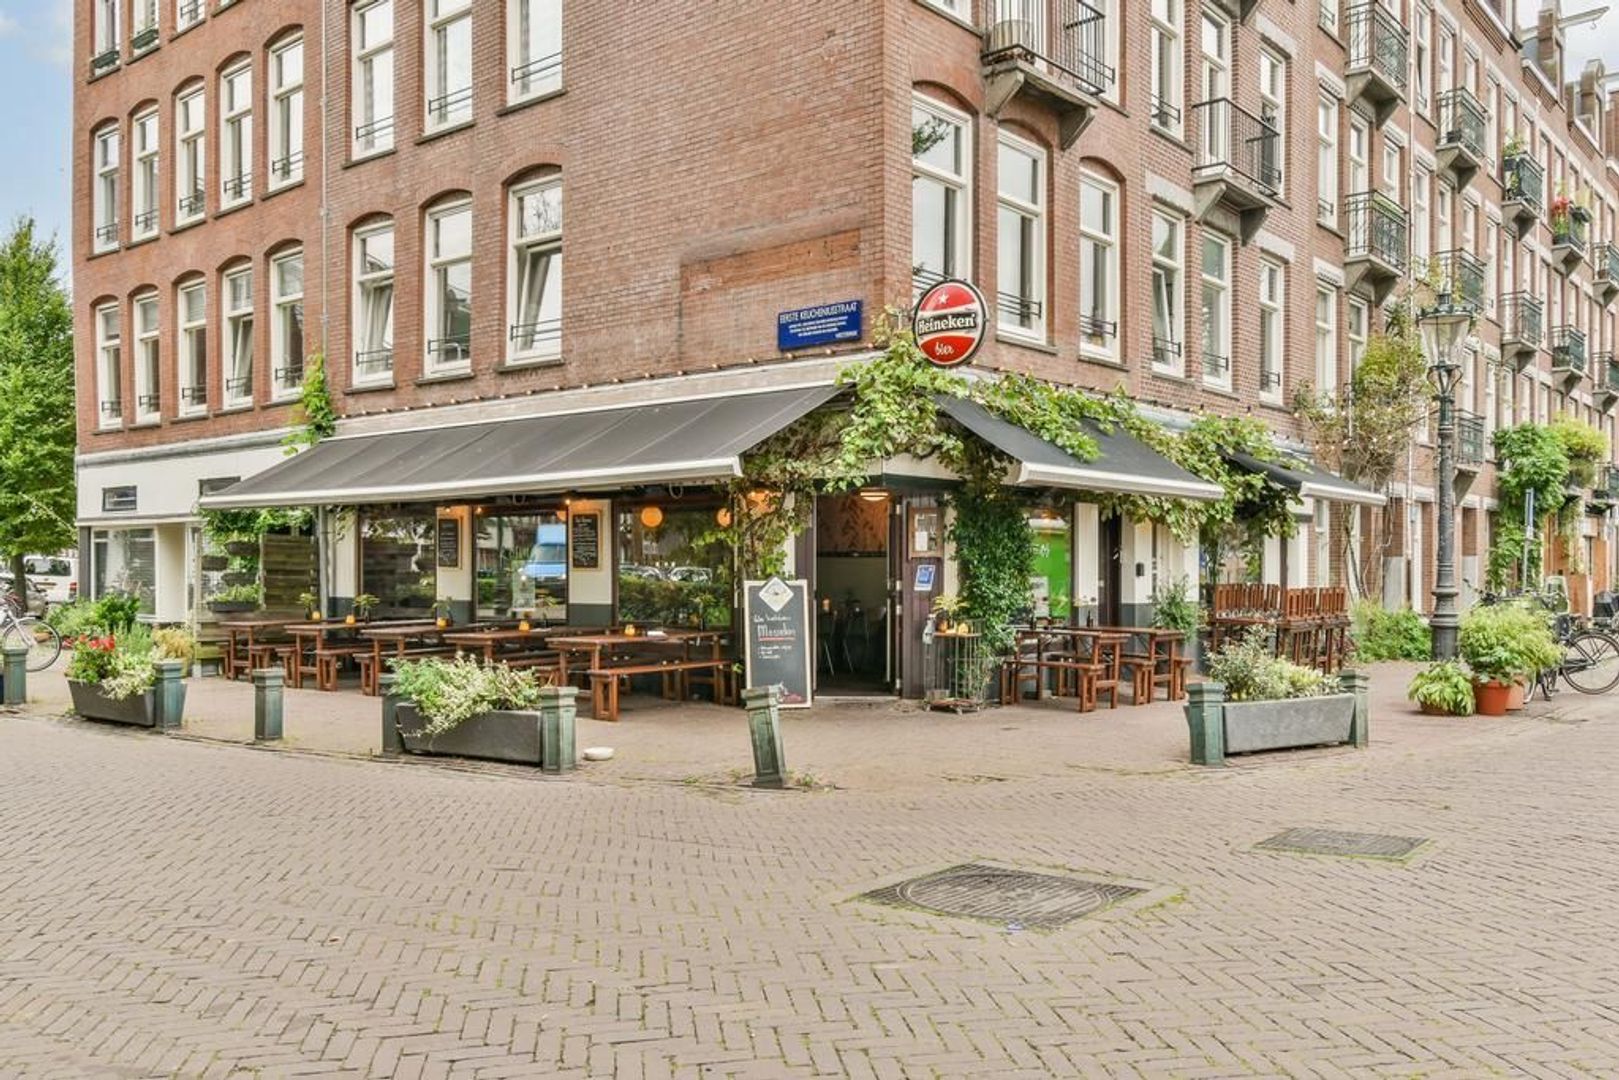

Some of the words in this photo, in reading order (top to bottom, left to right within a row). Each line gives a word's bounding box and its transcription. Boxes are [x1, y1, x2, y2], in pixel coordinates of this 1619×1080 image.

[780, 312, 799, 324] EERSTE
[918, 313, 976, 335] Heineken
[934, 342, 955, 356] bier
